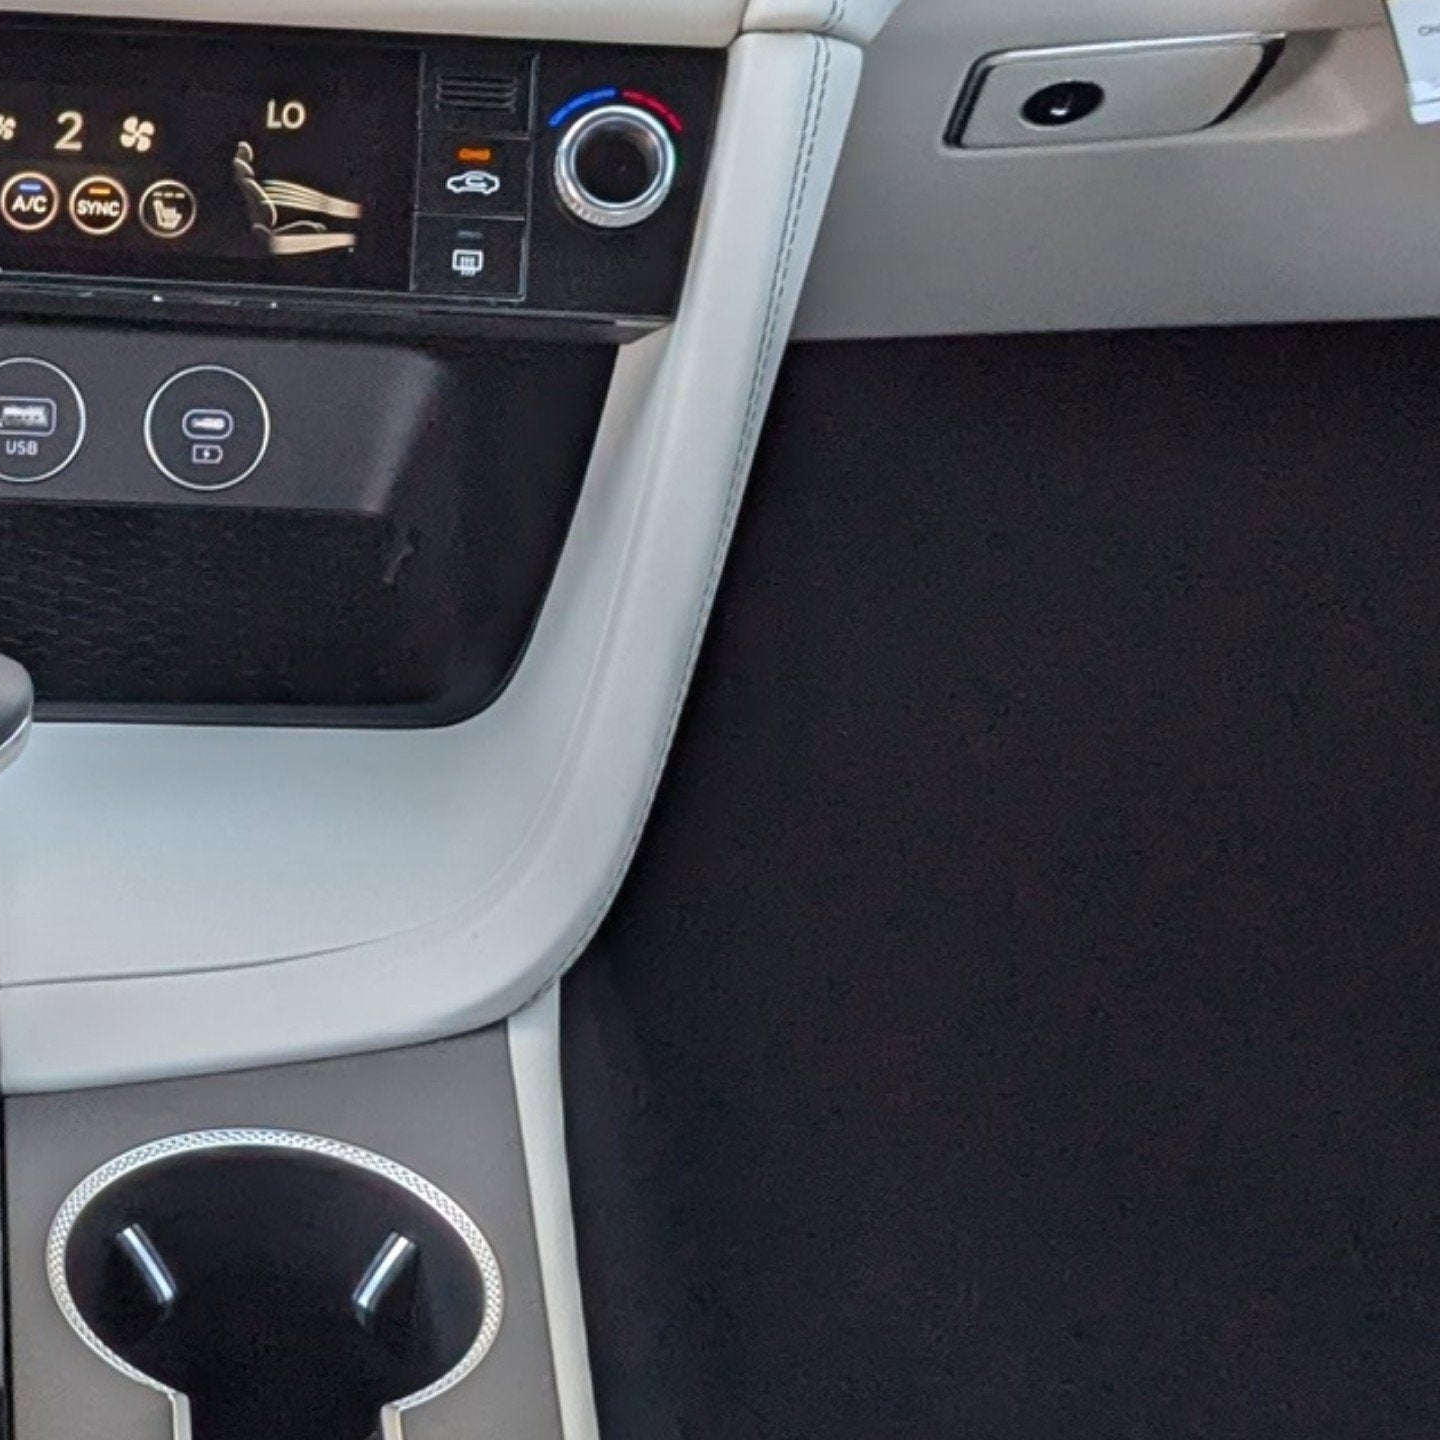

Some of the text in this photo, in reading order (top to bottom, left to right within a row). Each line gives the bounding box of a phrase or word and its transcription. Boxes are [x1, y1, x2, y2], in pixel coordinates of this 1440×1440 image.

[266, 100, 307, 130] LO
[54, 110, 84, 152] 2
[11, 195, 48, 214] A/C
[76, 198, 121, 218] SYNC
[5, 440, 39, 457] USB
